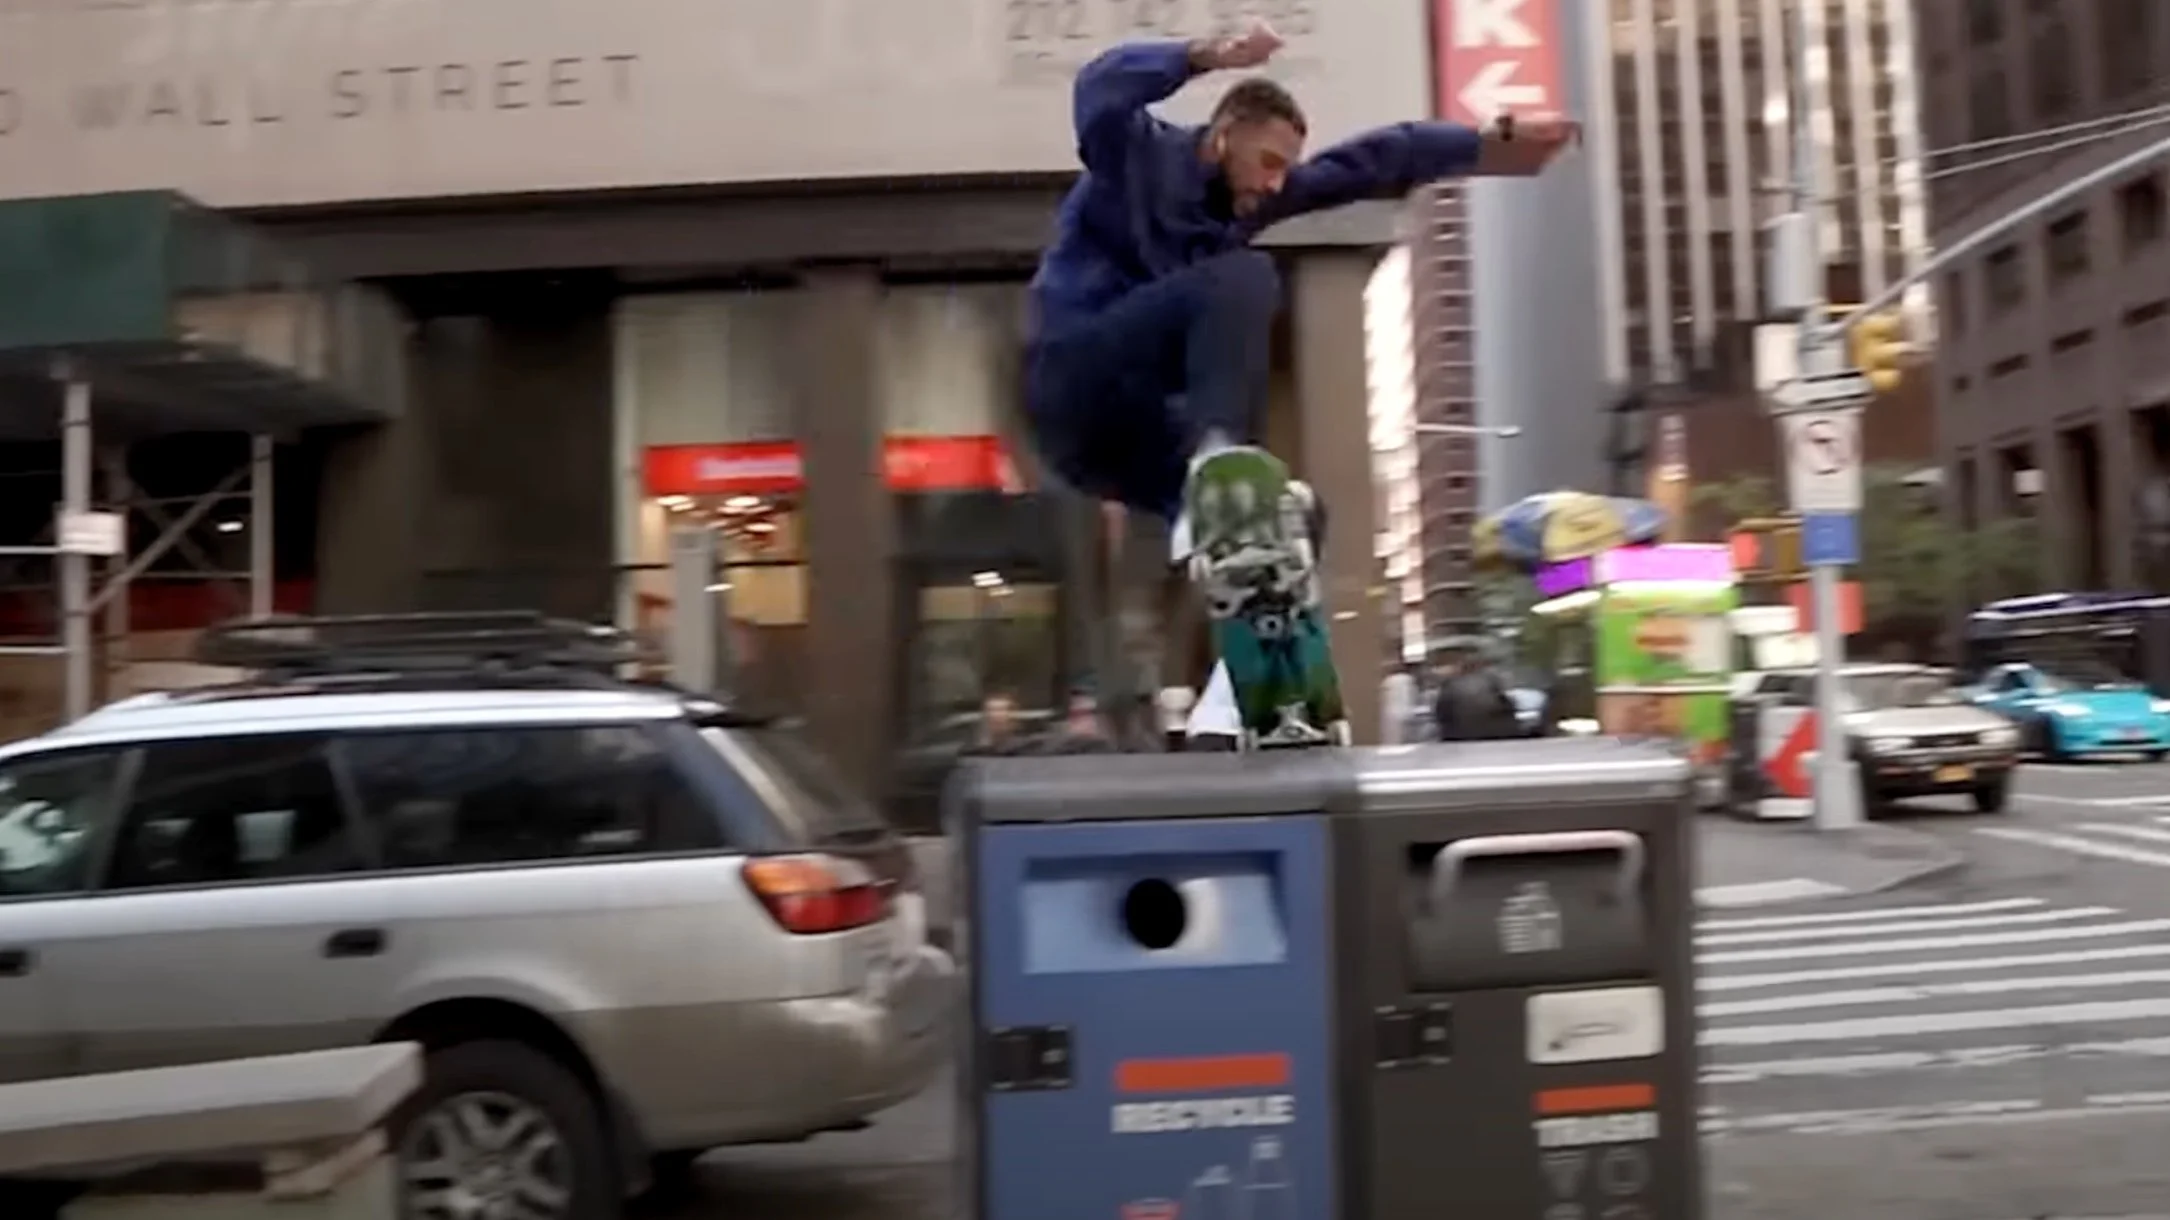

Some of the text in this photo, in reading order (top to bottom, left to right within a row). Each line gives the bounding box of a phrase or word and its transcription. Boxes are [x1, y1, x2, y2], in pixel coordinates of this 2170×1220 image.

[1453, 0, 1543, 47] K
[68, 79, 286, 129] WALL
[327, 54, 641, 119] STREET
[1111, 1094, 1296, 1133] RECYCLE
[1531, 1111, 1660, 1147] TRASH
